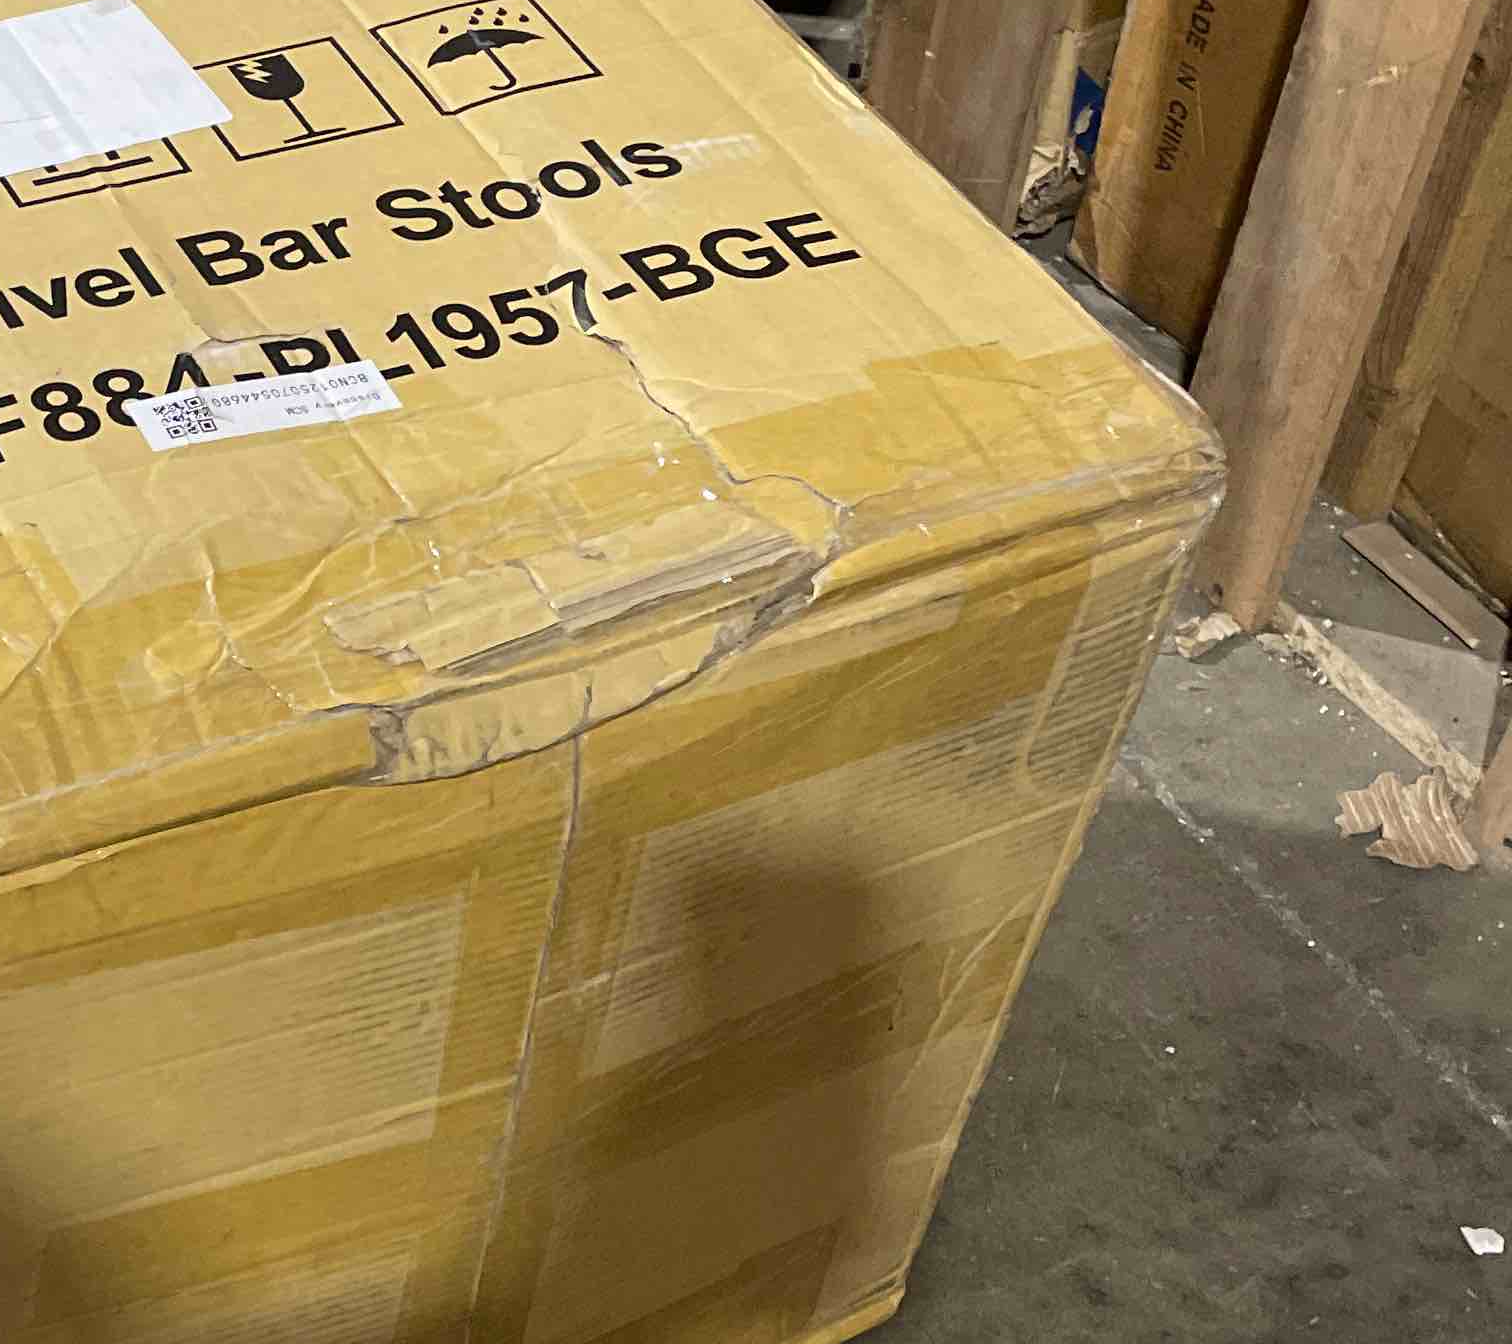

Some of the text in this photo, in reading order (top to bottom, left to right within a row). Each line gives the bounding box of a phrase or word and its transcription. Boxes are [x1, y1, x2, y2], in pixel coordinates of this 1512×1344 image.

[1175, 61, 1199, 91] IN
[1154, 99, 1189, 172] CHINA
[176, 217, 351, 287] Bar
[375, 138, 683, 242] Stools
